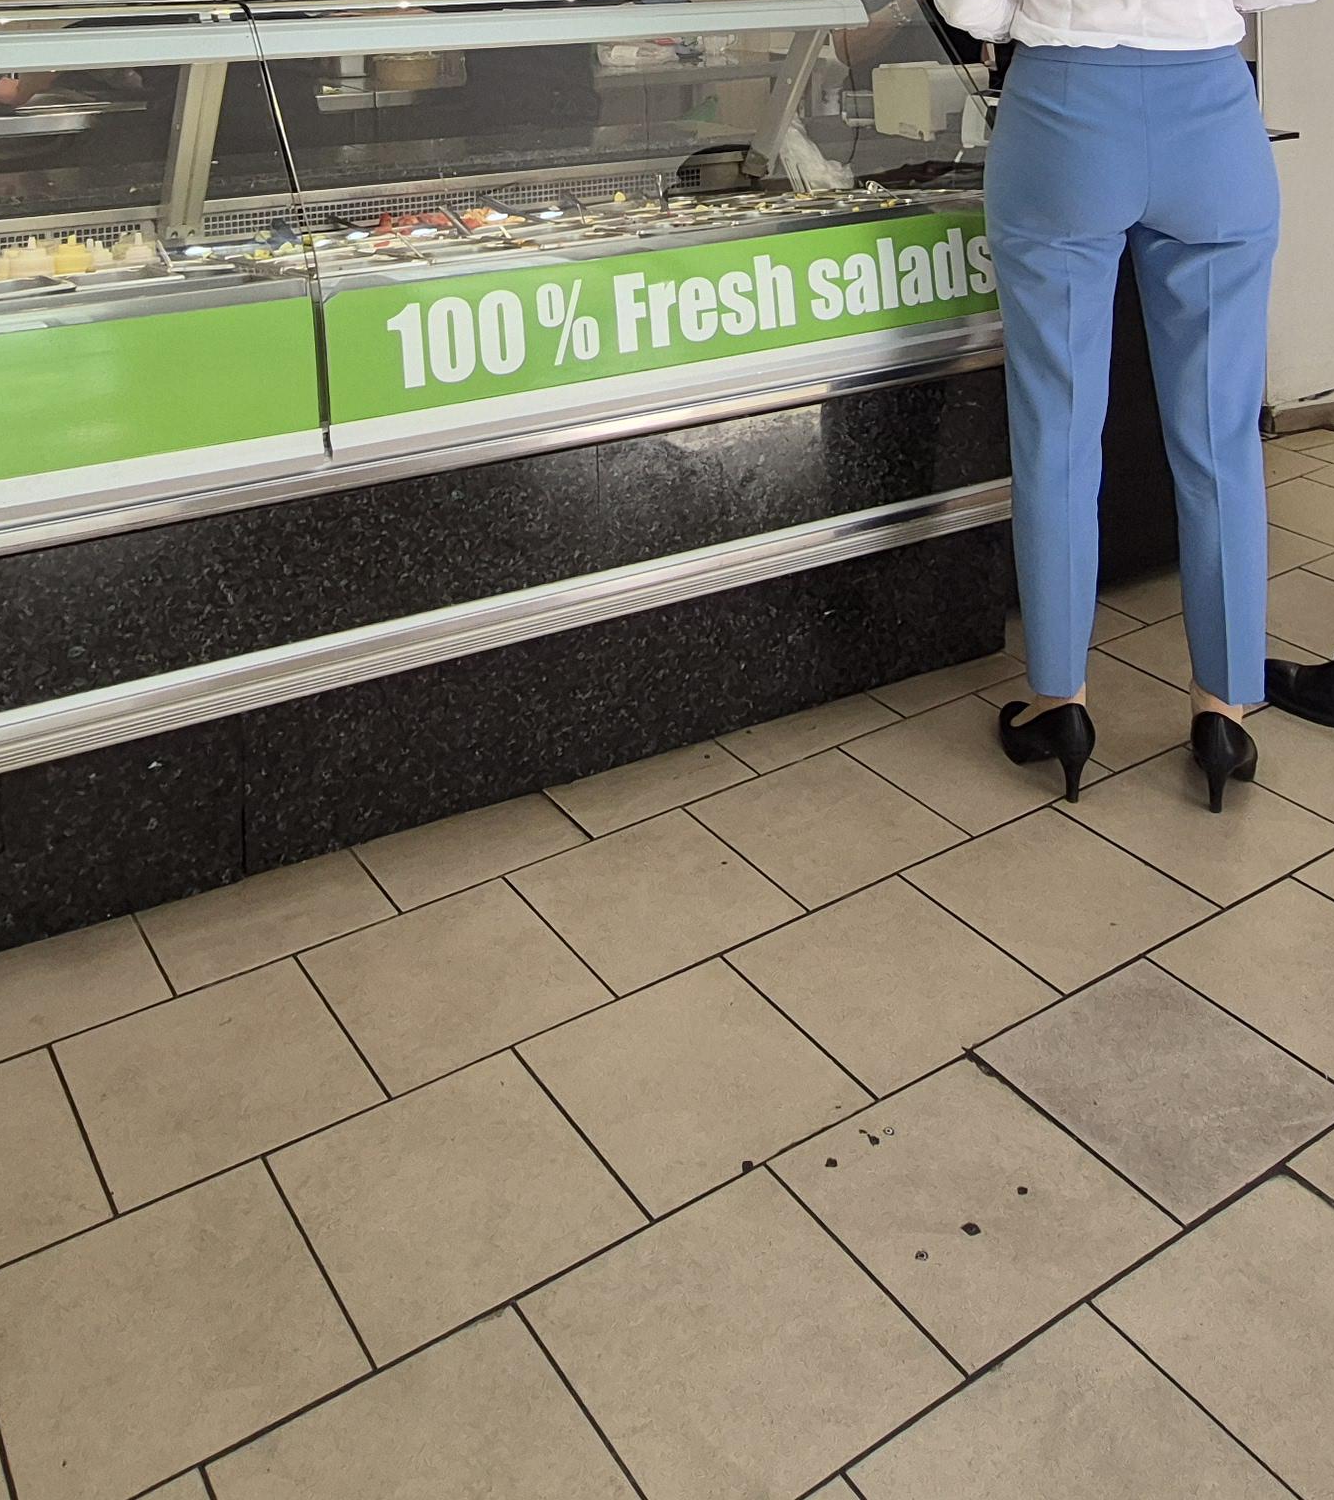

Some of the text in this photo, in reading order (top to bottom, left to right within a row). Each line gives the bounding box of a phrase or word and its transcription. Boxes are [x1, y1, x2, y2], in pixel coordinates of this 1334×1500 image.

[385, 227, 997, 390] 100 % Fresh salads
